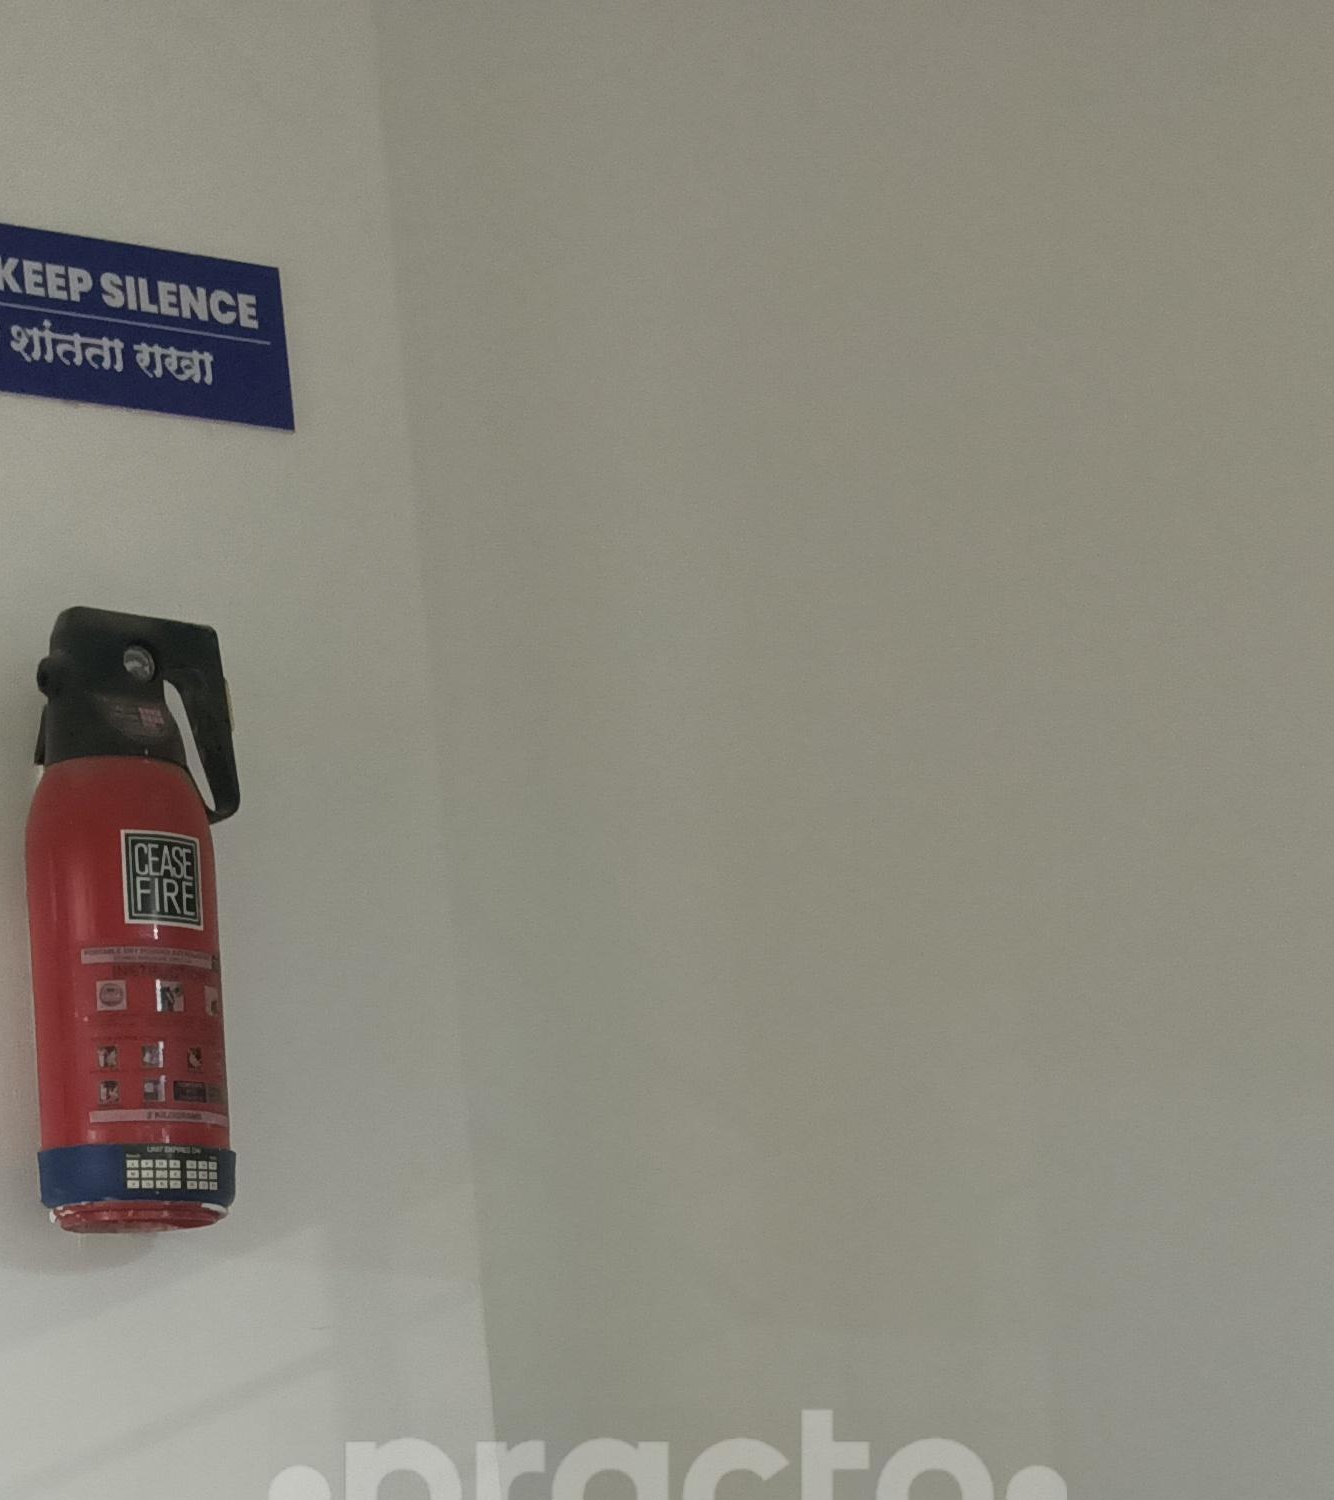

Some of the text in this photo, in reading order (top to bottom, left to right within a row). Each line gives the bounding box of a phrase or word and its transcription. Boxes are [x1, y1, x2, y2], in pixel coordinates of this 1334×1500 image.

[101, 272, 260, 329] SILENCE
[9, 319, 125, 374] शांतता
[133, 341, 214, 386] राखा
[133, 841, 194, 880] CEASE
[135, 878, 197, 918] FIRE
